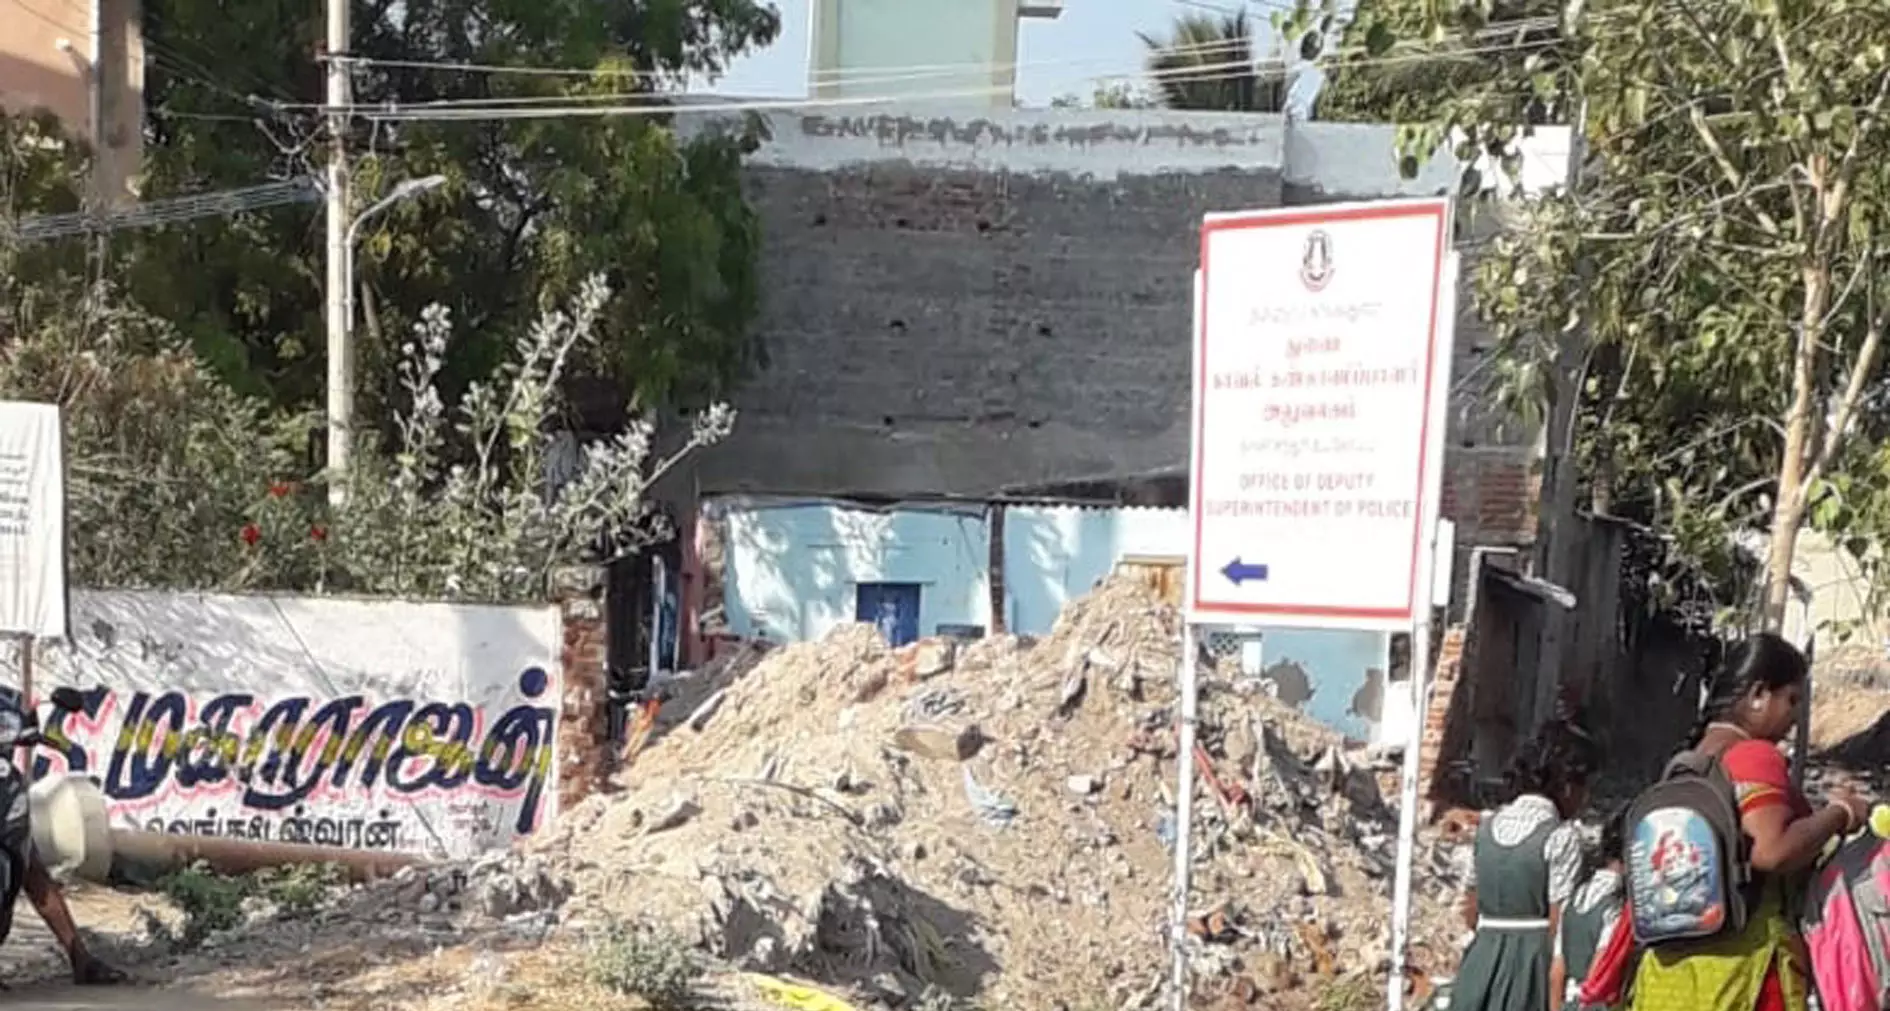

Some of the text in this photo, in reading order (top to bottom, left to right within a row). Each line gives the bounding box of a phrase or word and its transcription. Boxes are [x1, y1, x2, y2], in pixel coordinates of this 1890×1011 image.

[1239, 471, 1376, 491] OFFICE OF DEPUTY
[1204, 499, 1411, 518] SUPERINTENDENT OF POLICE
